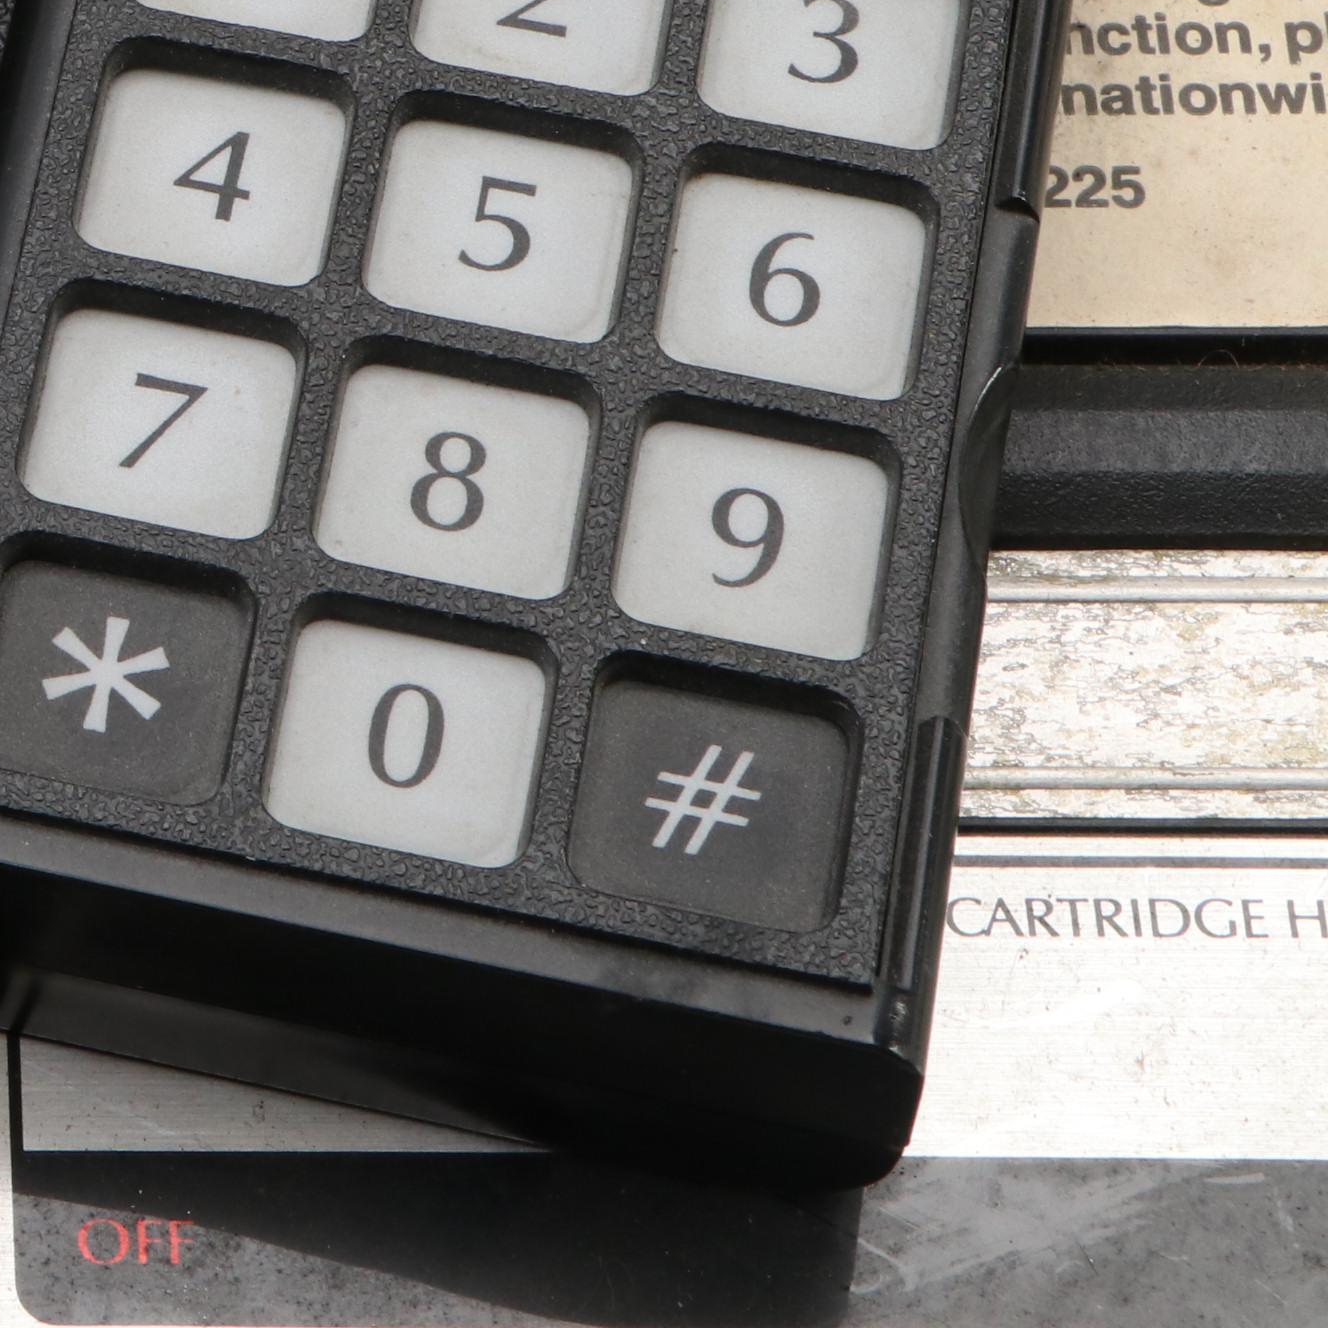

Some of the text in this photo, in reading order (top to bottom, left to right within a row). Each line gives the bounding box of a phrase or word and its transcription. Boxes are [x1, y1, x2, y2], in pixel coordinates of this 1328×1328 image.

[174, 132, 820, 326] 4 5 6
[120, 373, 784, 587] 7 8 9
[368, 684, 444, 788] 0
[945, 896, 1270, 939] CARTRIDGE
[76, 1217, 197, 1266] OFF
